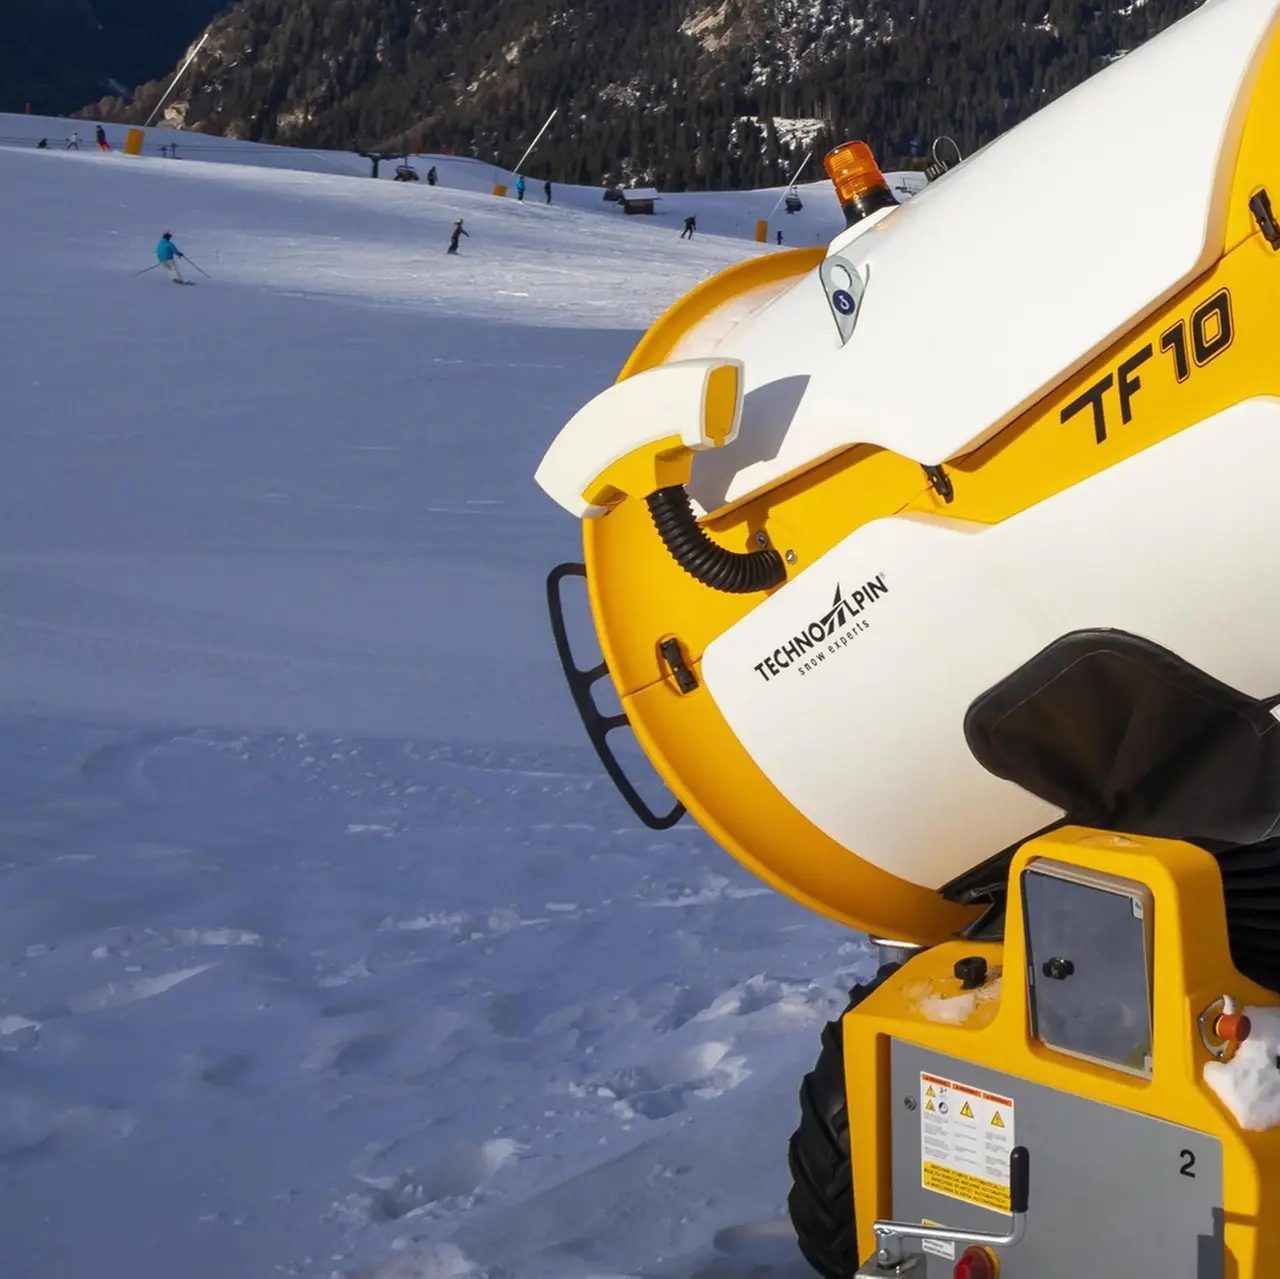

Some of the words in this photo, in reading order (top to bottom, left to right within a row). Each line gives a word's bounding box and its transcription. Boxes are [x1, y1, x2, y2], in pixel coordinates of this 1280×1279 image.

[798, 651, 826, 676] snow
[828, 619, 870, 654] experts
[1180, 1149, 1196, 1179] 2
